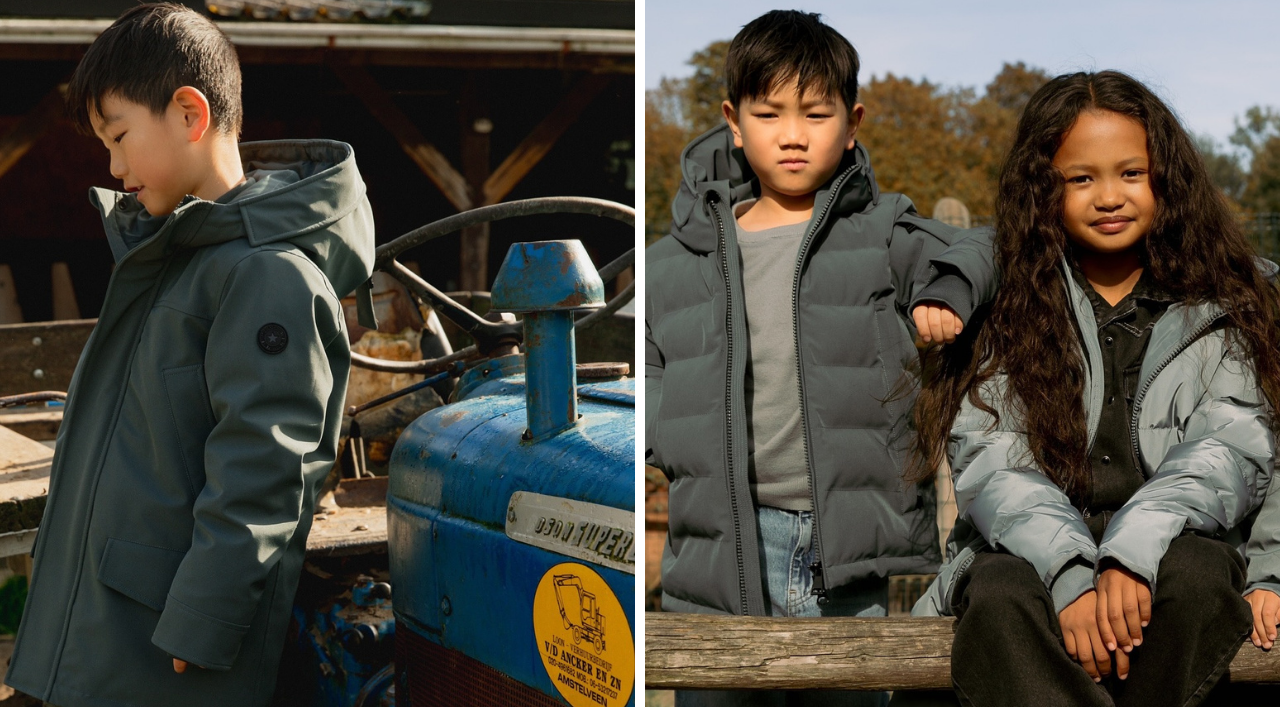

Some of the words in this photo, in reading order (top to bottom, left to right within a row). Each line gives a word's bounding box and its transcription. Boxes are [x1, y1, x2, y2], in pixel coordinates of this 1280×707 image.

[571, 521, 634, 559] SUPER
[552, 635, 564, 647] LOON
[545, 642, 558, 657] V/D
[561, 650, 593, 676] ANCKER
[596, 668, 607, 683] EN
[610, 675, 621, 691] ZN
[558, 673, 607, 707] AMSTELVEEN
